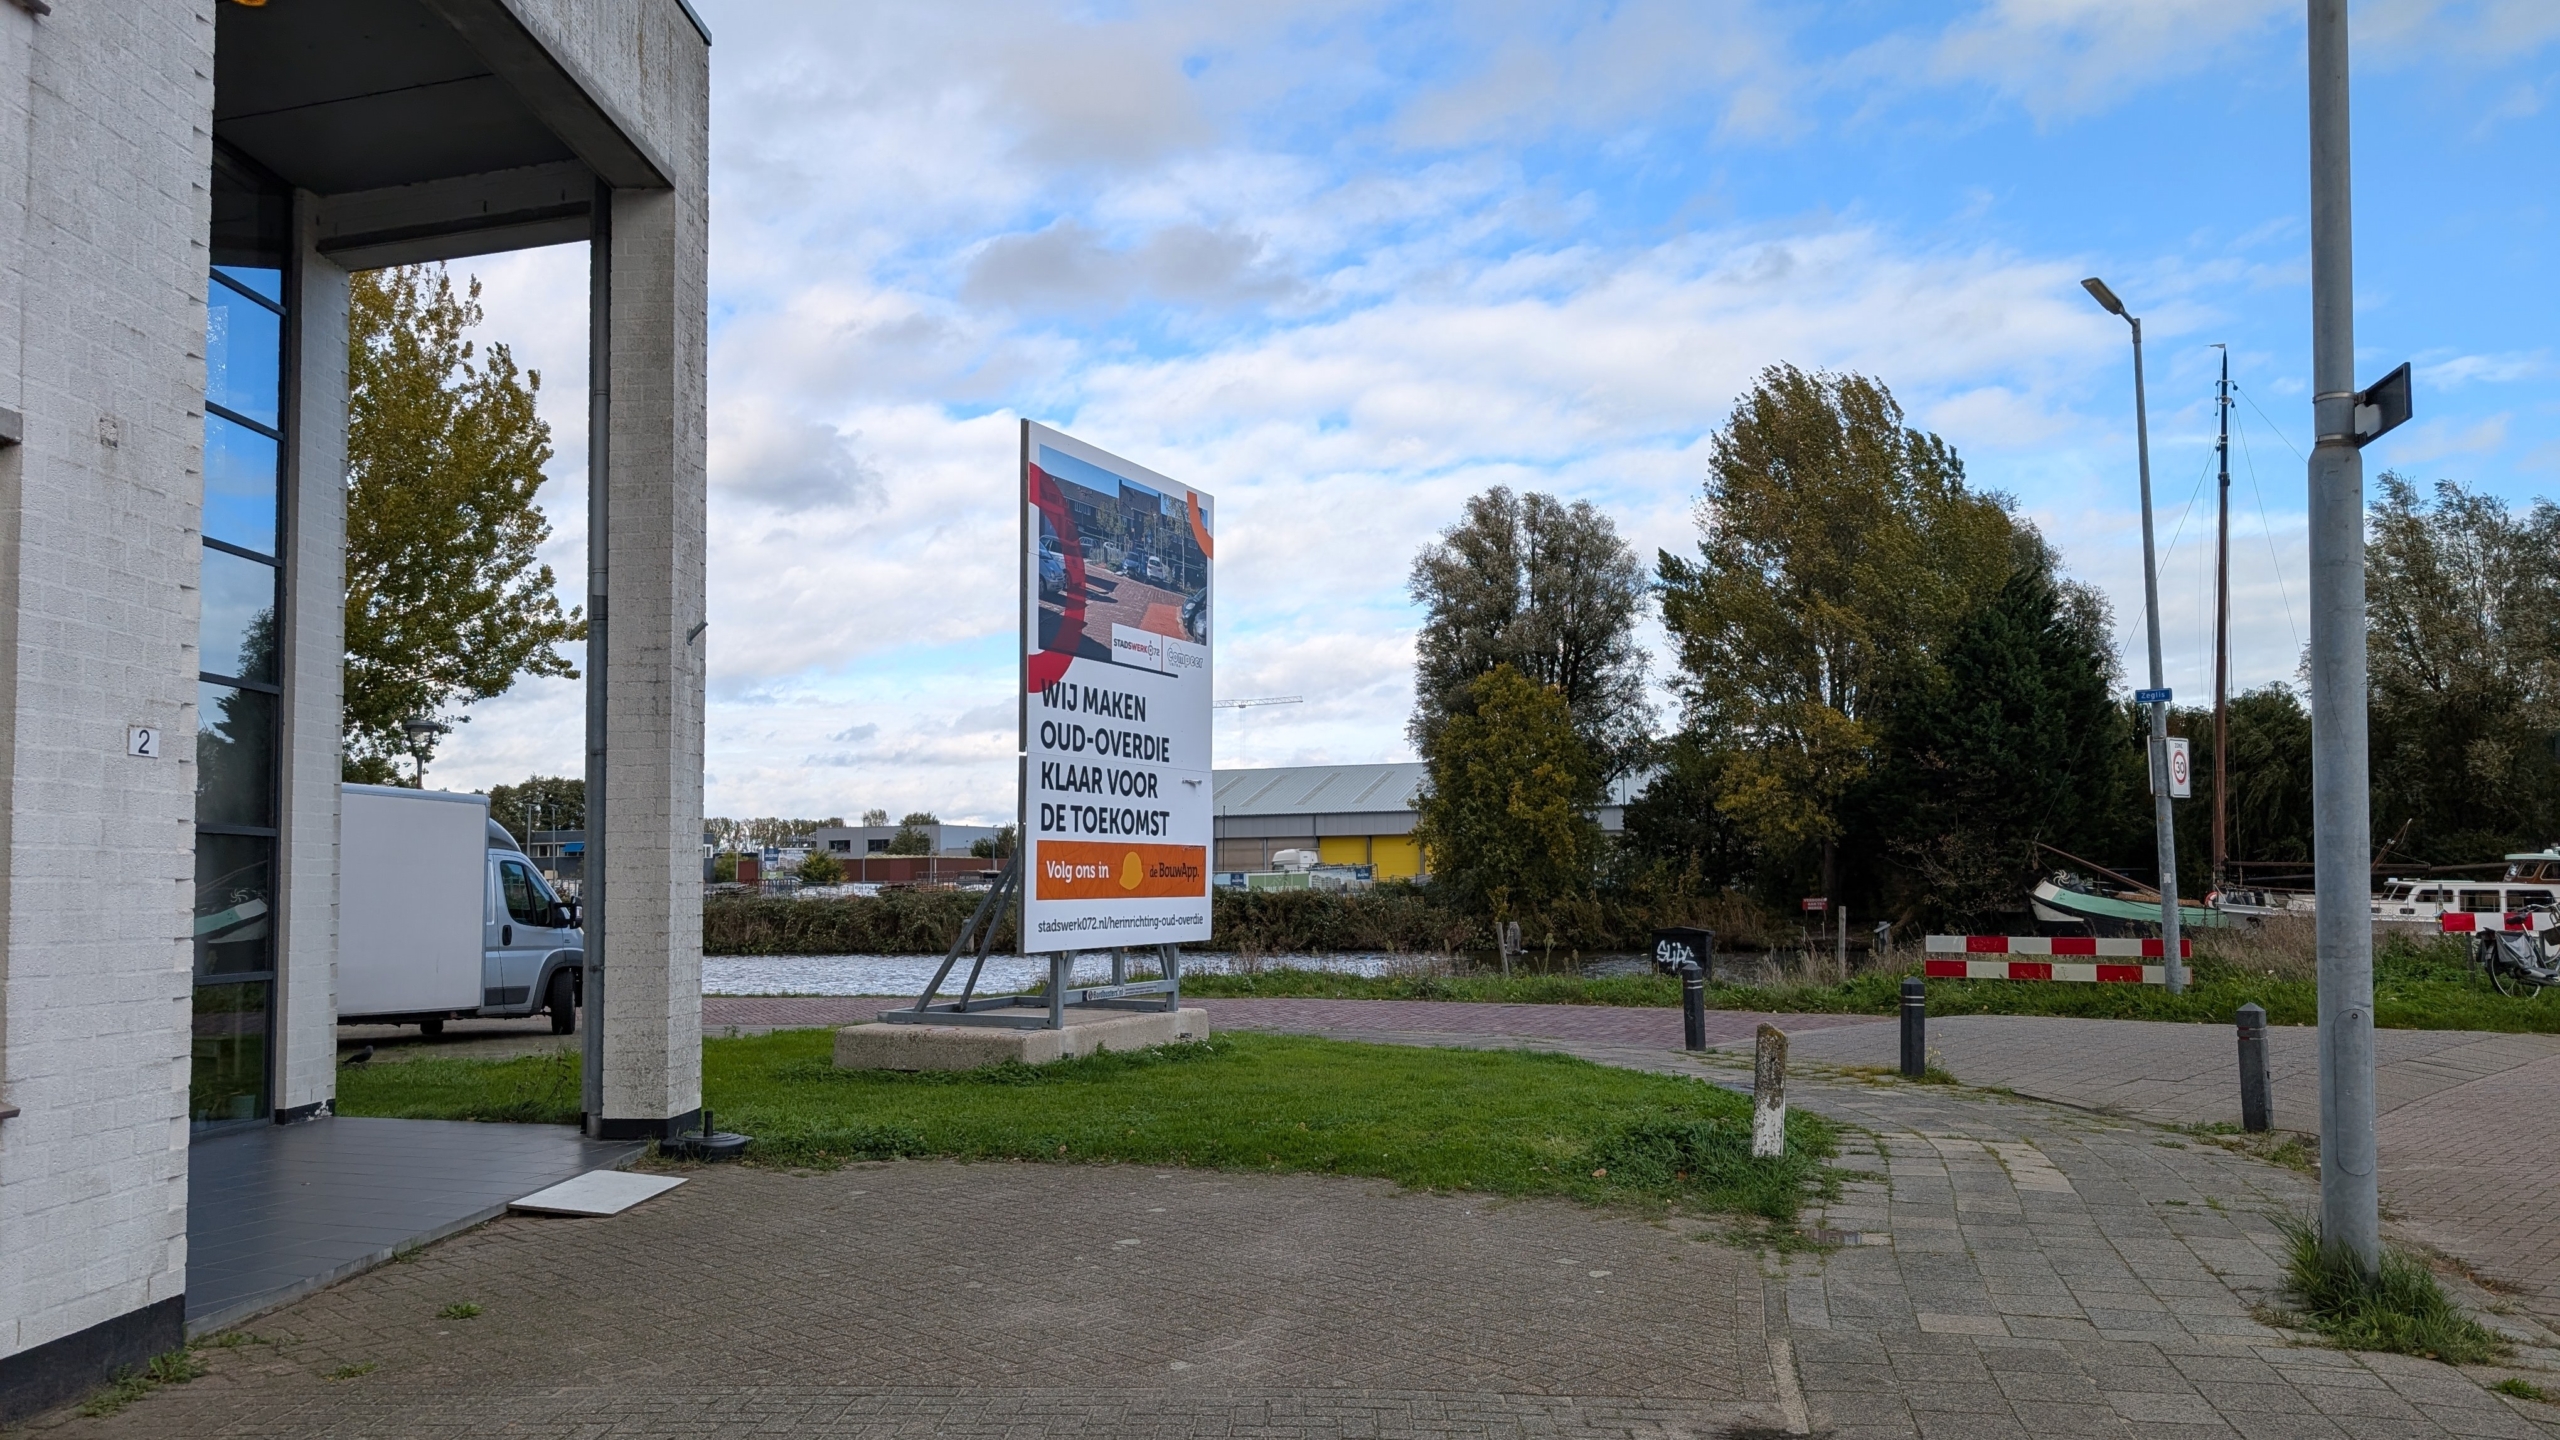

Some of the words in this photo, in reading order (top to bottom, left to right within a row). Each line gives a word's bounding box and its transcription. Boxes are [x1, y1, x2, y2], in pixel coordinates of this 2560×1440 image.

[1041, 678, 1078, 712] WIJ
[1083, 685, 1146, 722] MAKEN
[2141, 691, 2166, 700] Zeglis
[138, 729, 150, 755] 2
[1040, 720, 1170, 763] OUD-OVERDIE
[1041, 761, 1103, 795] KLAAR
[1107, 768, 1158, 799] VOOR
[2175, 761, 2185, 775] 30
[1040, 802, 1067, 832] DE
[1070, 805, 1170, 837] TOEKOMST
[1046, 860, 1073, 883] Volg
[1075, 865, 1096, 879] ons
[1098, 861, 1110, 879] in
[1149, 865, 1158, 878] de
[1037, 912, 1204, 933] stadswerk072.nl/herinrichting-oud-overdie
